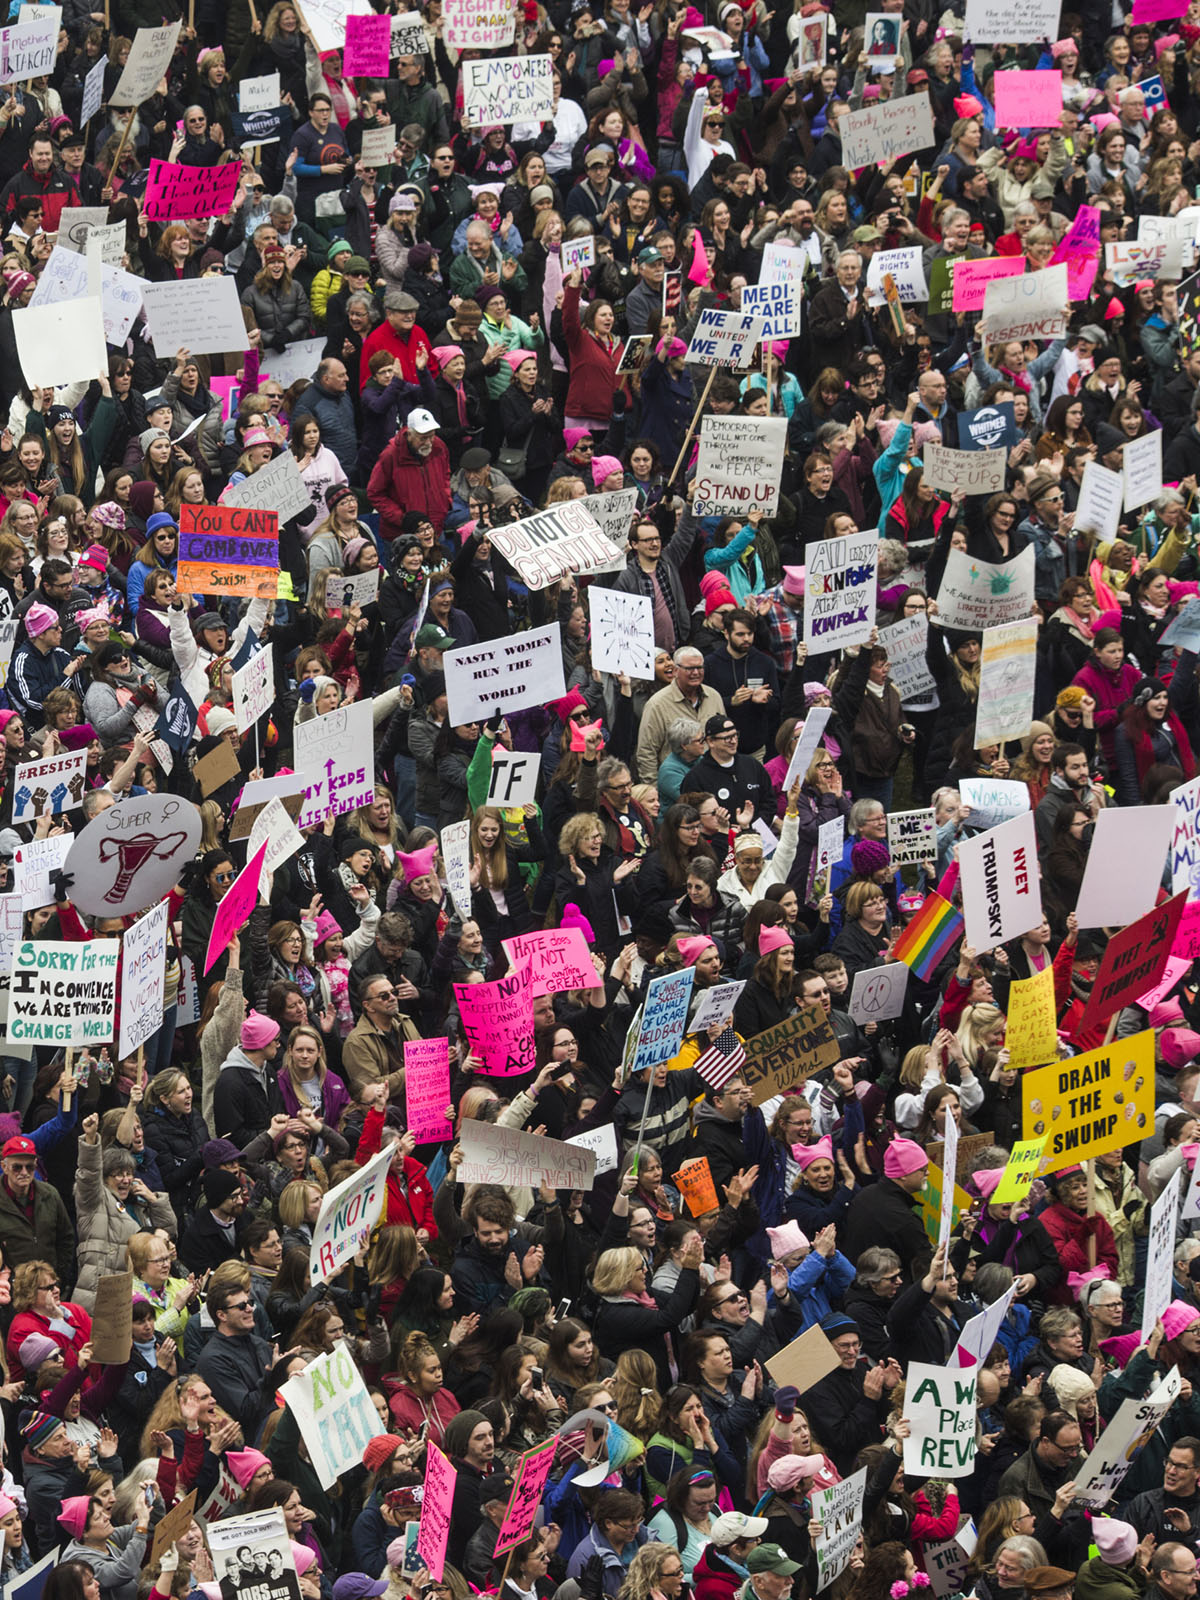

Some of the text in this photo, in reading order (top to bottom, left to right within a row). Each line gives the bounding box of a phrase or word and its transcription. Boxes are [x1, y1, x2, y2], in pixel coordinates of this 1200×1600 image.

[453, 16, 506, 27] HUMAN
[473, 59, 552, 86] EMPOWERED
[487, 84, 536, 102] WOMEN
[468, 101, 521, 123] EMPOWER
[242, 117, 281, 133] WHITMER
[881, 137, 926, 156] Women
[566, 247, 590, 263] LOVE
[702, 311, 751, 329] WE R
[761, 320, 797, 337] ALL!
[709, 329, 748, 341] UNITED!
[692, 339, 742, 358] WE R
[969, 416, 1007, 436] WHITMER
[931, 467, 968, 484] RISE
[699, 480, 750, 501] STAND
[188, 510, 224, 532] YOU
[497, 504, 601, 558] DO NOT GO
[514, 530, 621, 588] GENTLE
[455, 637, 552, 667] NASTY WOMEN
[473, 658, 532, 680] RUN THE
[478, 685, 526, 702] WORLD
[18, 757, 83, 780] #RESIST
[329, 769, 365, 790] KIDS
[299, 791, 373, 828] LISTENING
[891, 814, 934, 824] EMPOWER
[899, 822, 920, 836] ME
[891, 836, 931, 846] EMPOWER
[892, 849, 936, 863] NATION
[1013, 848, 1029, 895] NYET
[982, 839, 1002, 938] TRUMPSKY
[18, 944, 116, 970] SORRY FOR THE
[513, 936, 571, 958] HATE does
[541, 949, 565, 966] NOT
[546, 974, 587, 991] GREAT
[16, 1001, 112, 1016] WE ARE TRYING TO
[656, 1006, 686, 1026] US ARE
[11, 1018, 112, 1039] CHANGE WORLD
[662, 1020, 683, 1039] BACK
[745, 1008, 817, 1053] EQUALITY
[635, 1046, 678, 1066] MALALA
[745, 1023, 831, 1084] EVERYONE
[1059, 1059, 1110, 1093] DRAIN
[1069, 1090, 1101, 1118] THE
[1052, 1116, 1118, 1154] SWUMP
[332, 1186, 374, 1240] NOT
[311, 1351, 354, 1413] NO
[824, 1482, 851, 1503] When
[825, 1509, 854, 1540] LAW
